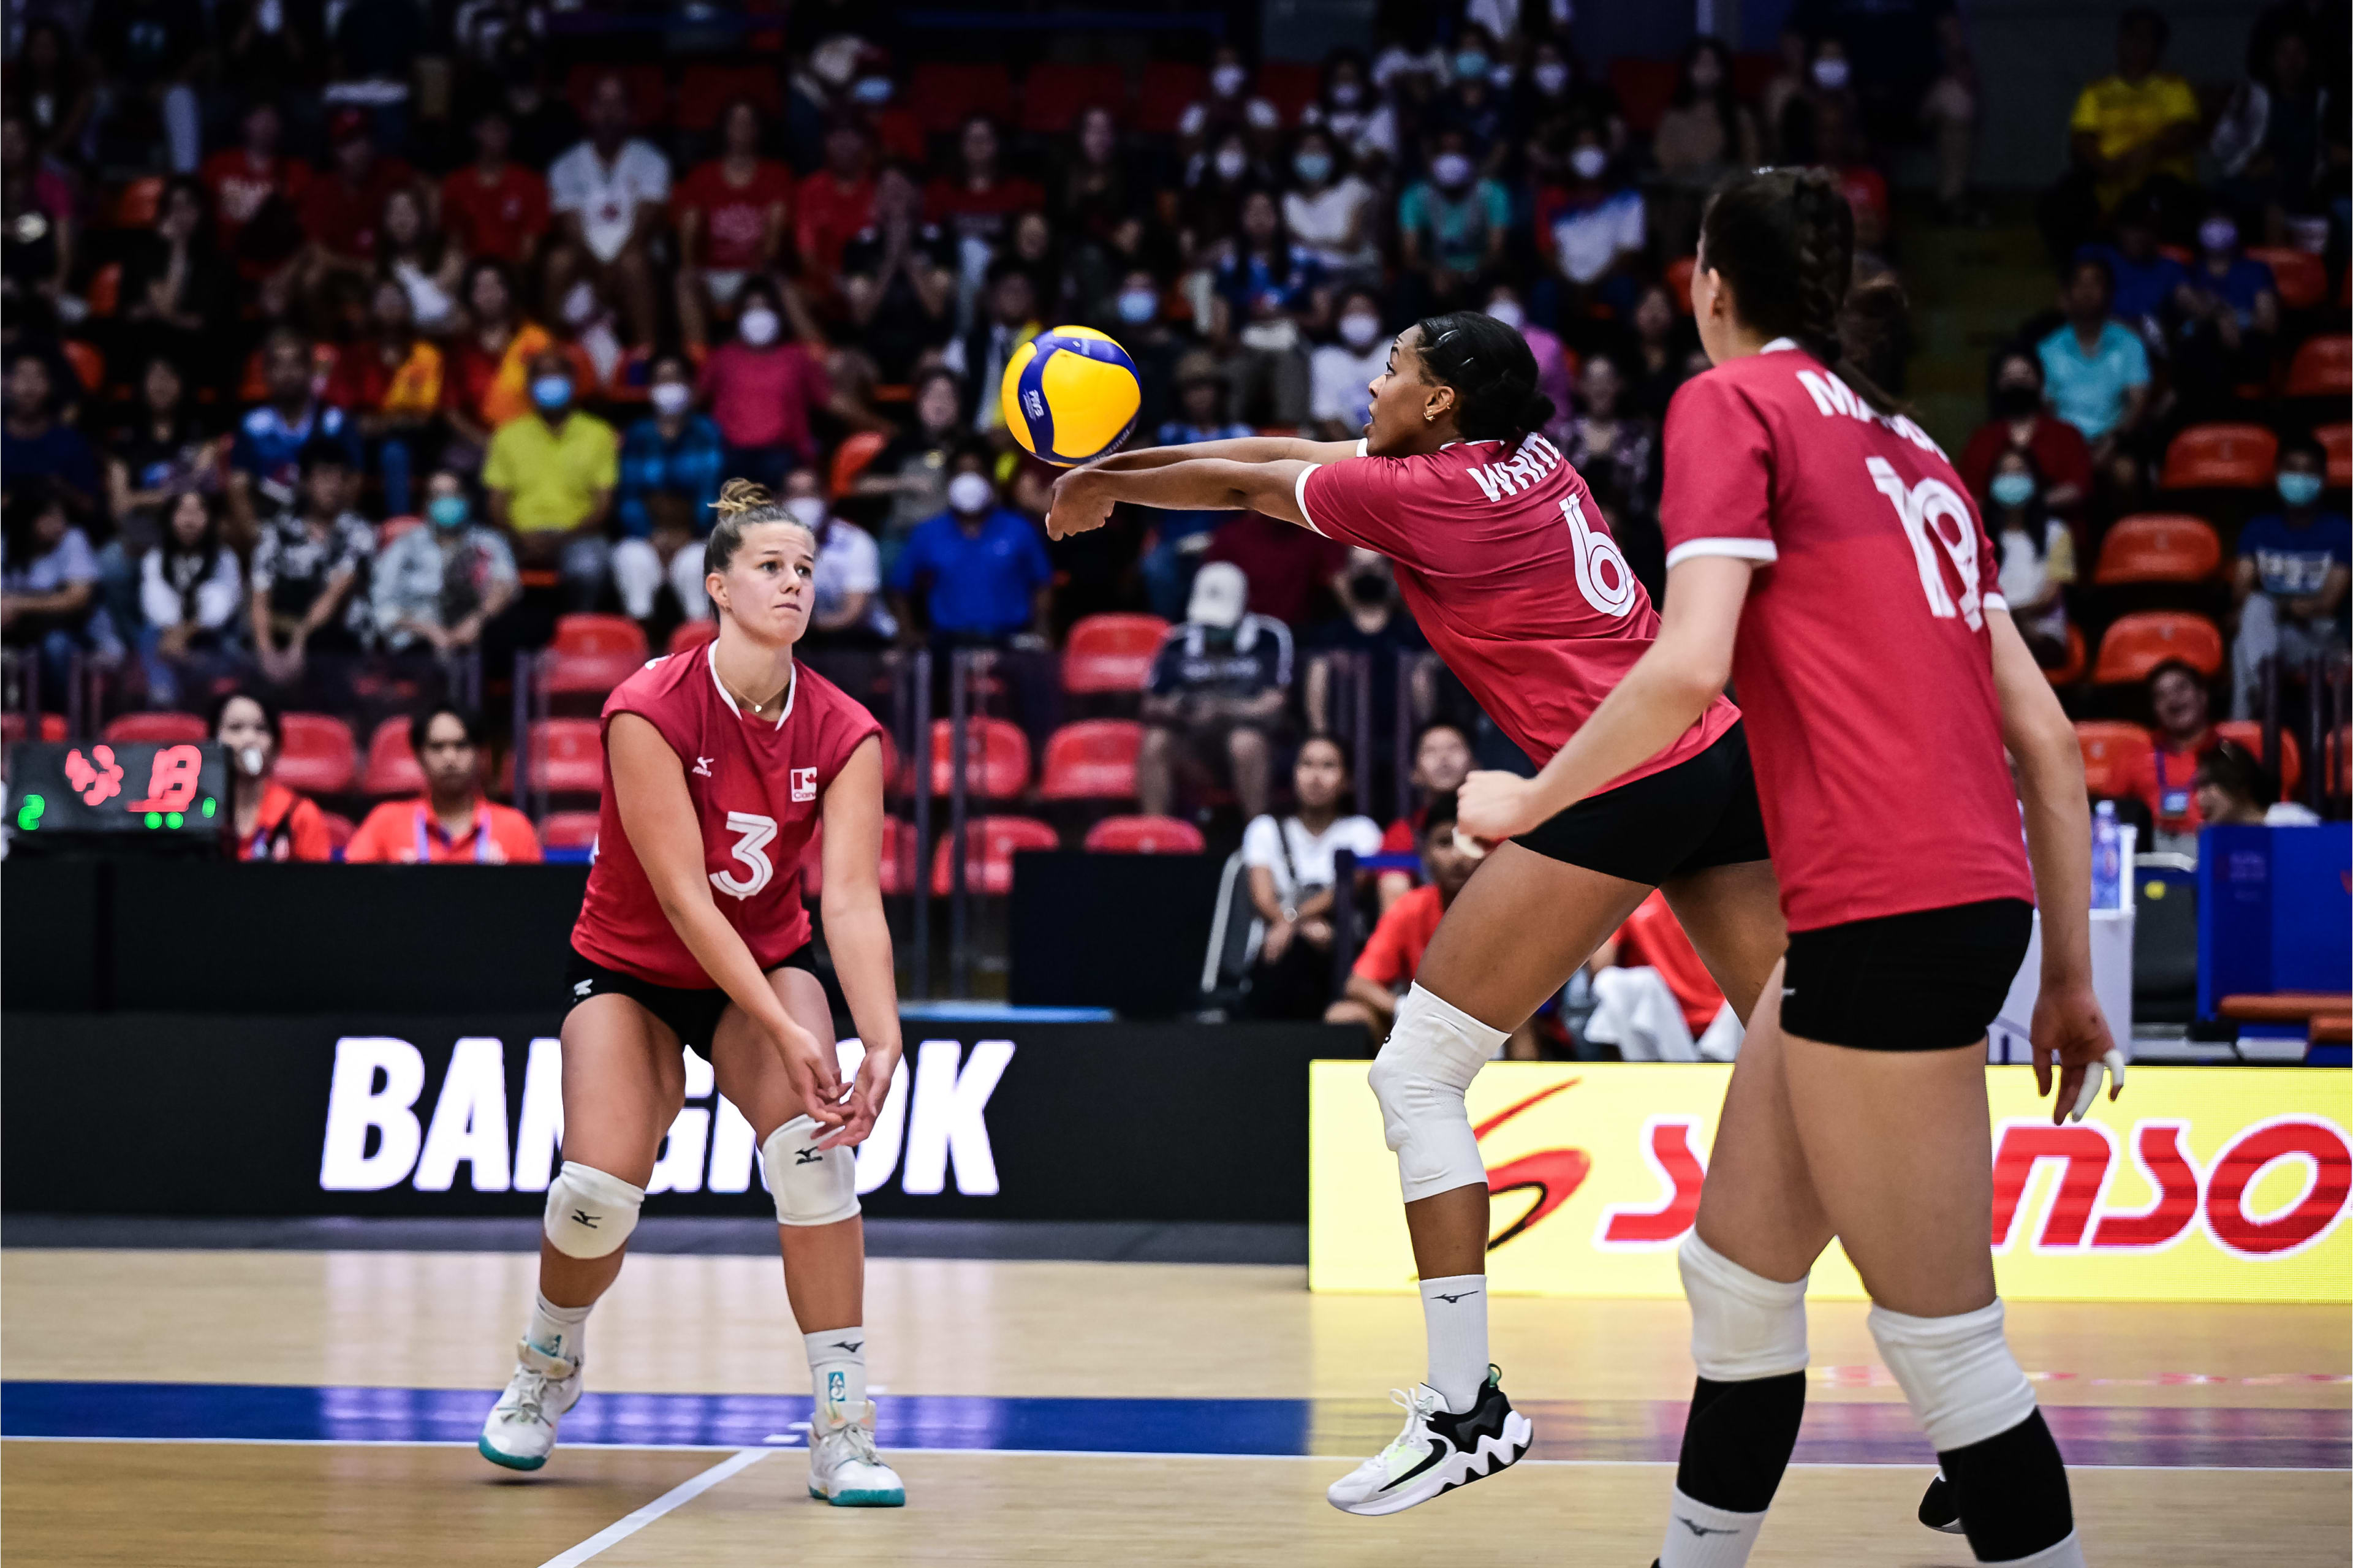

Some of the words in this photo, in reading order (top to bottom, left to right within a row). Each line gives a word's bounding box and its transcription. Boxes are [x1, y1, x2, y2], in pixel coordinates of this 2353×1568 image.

[1466, 431, 1561, 502] WHIT
[1558, 492, 1635, 617] 6
[1865, 456, 1983, 632] 19
[709, 811, 778, 901] 3
